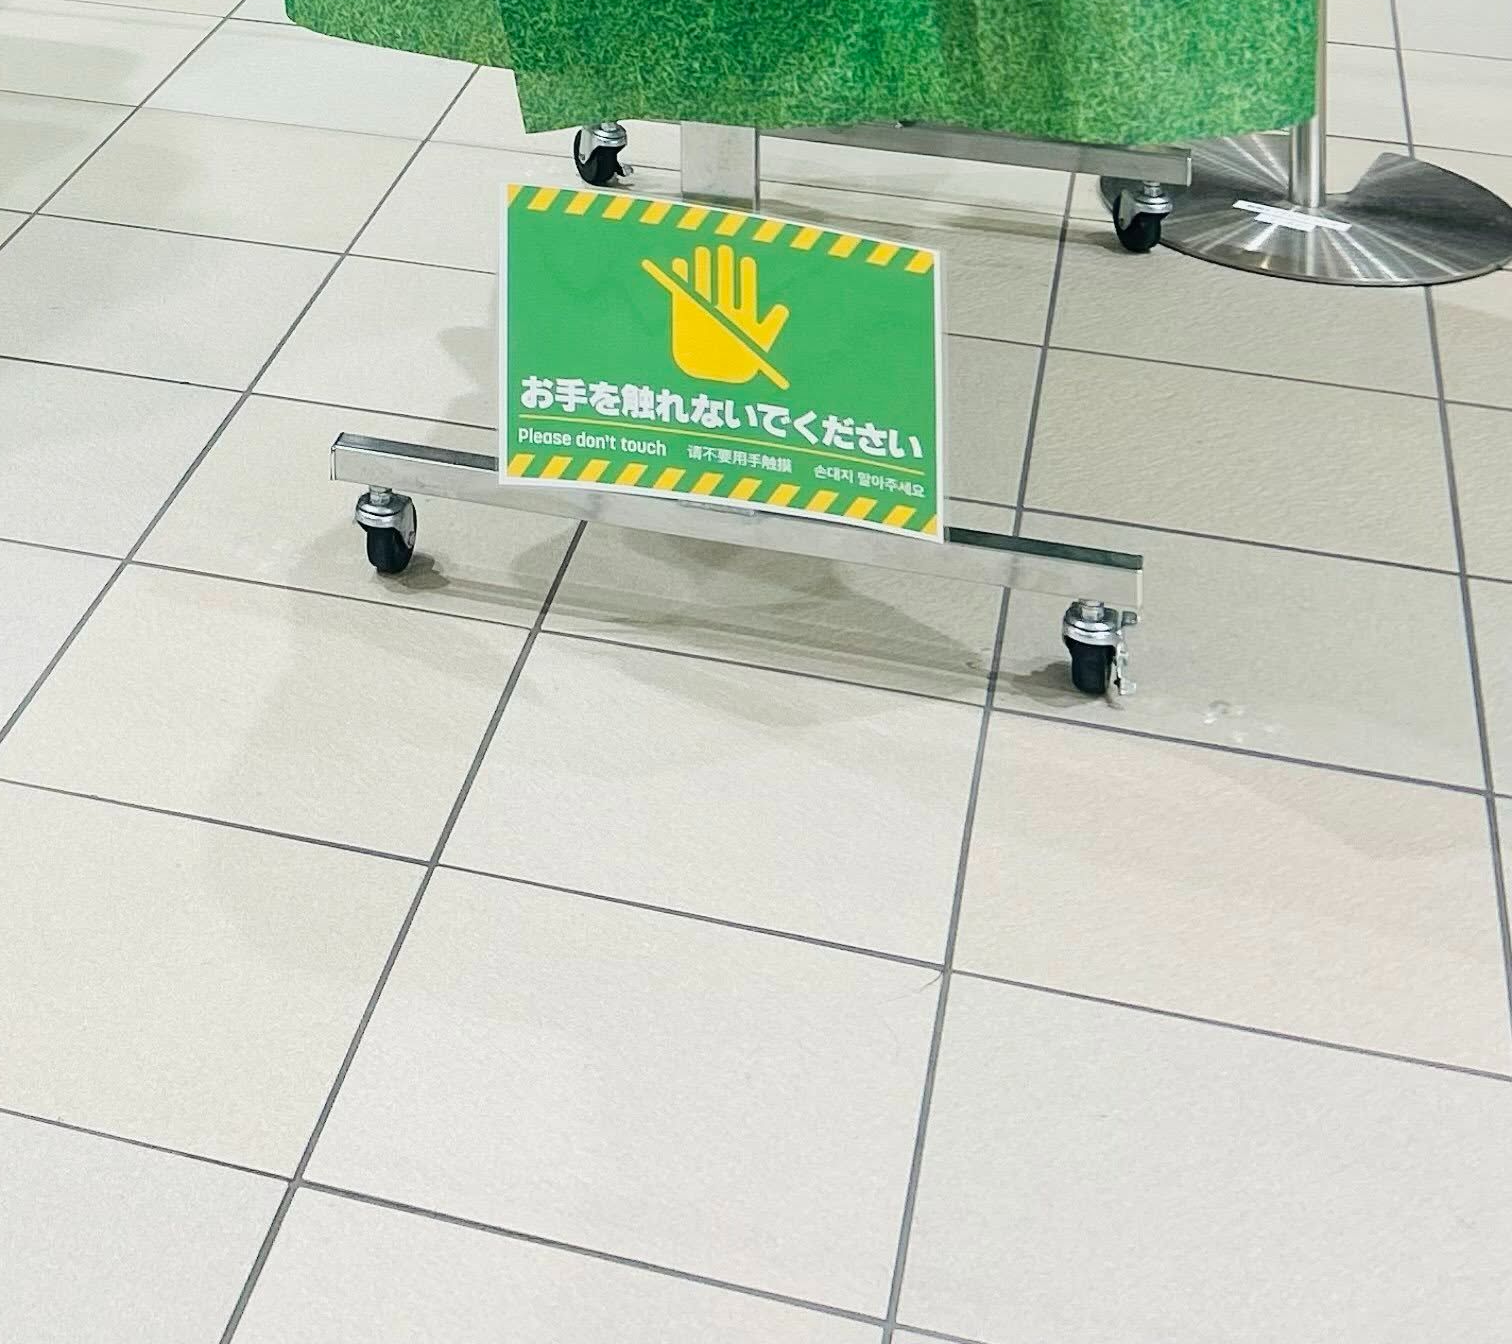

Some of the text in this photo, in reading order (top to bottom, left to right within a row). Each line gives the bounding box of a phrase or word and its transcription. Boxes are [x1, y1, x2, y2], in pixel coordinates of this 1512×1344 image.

[520, 375, 925, 460] お手を触れないでください
[518, 428, 668, 458] Please don't touch
[686, 444, 793, 475] 请不要用手触摸
[813, 465, 926, 499] 손대지 말아주세요
